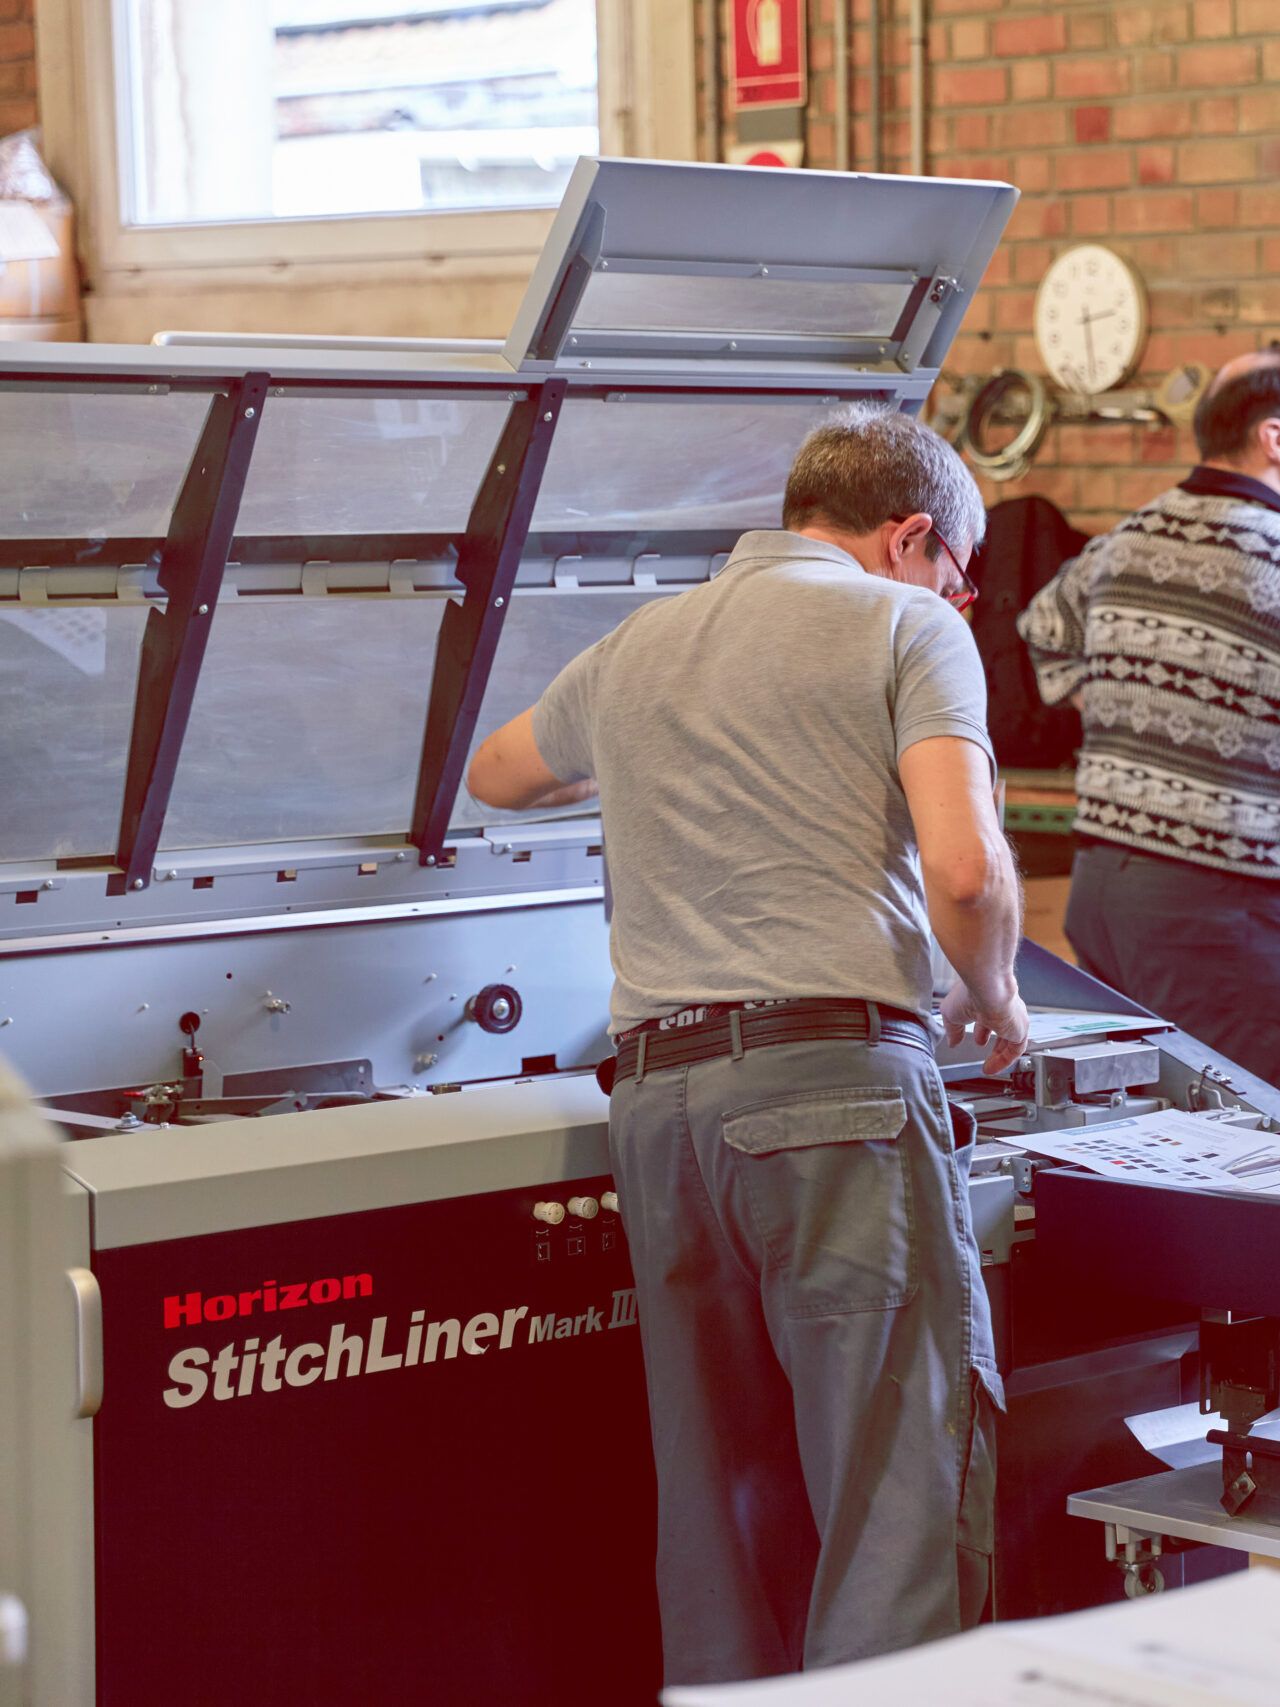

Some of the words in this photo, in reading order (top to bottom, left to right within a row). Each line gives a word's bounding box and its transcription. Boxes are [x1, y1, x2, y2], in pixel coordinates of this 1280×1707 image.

[164, 1273, 373, 1329] Horizon
[163, 1305, 529, 1409] StitchLiner
[528, 1305, 604, 1344] Mark
